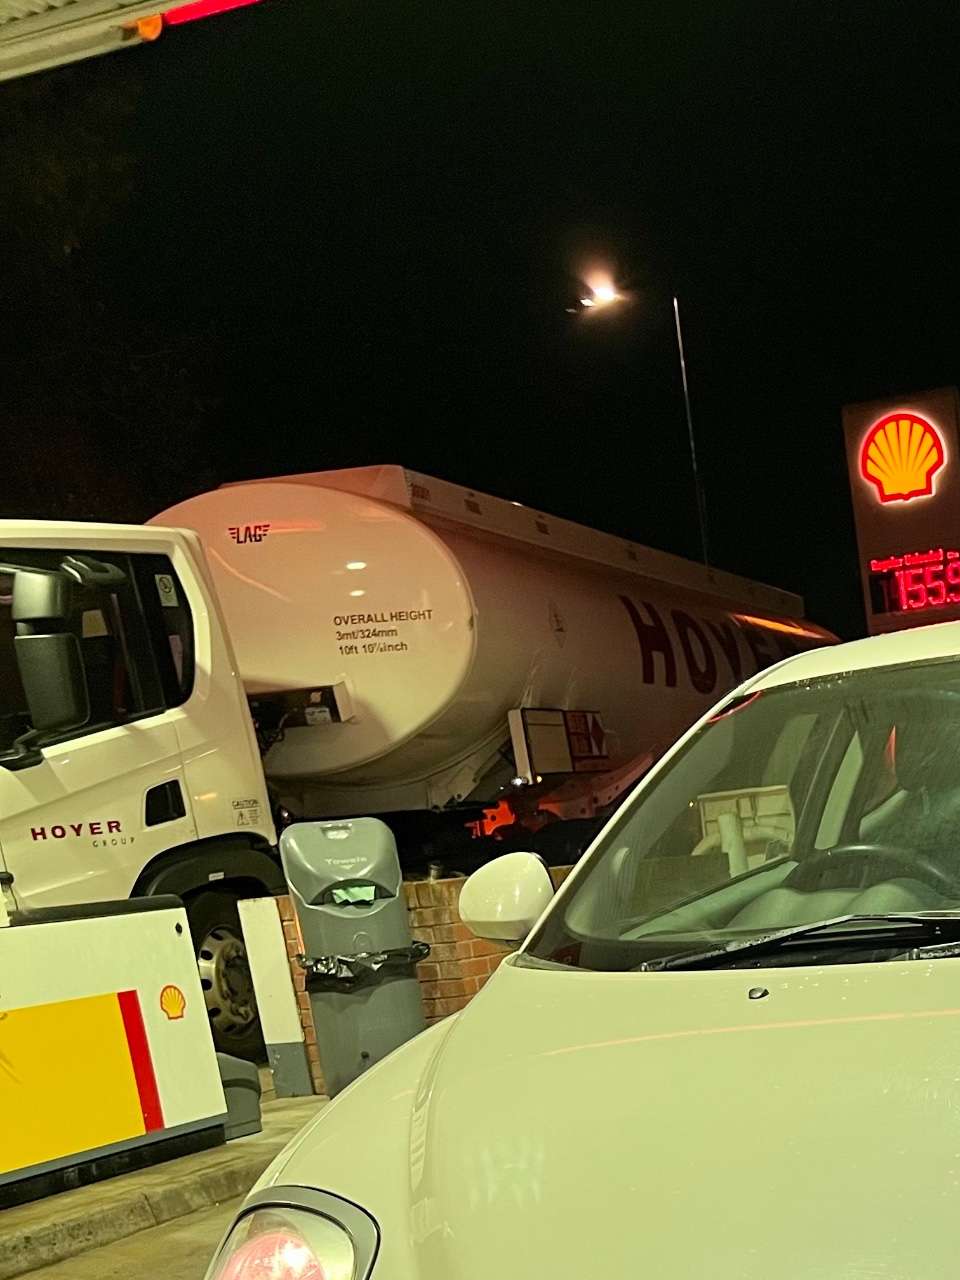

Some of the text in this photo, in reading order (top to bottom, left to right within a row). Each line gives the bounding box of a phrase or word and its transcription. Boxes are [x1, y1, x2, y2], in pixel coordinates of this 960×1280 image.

[235, 524, 266, 544] LAG
[333, 609, 432, 625] OVERALL HEIGHT
[30, 820, 122, 841] HOYER
[92, 836, 136, 848] GROUP
